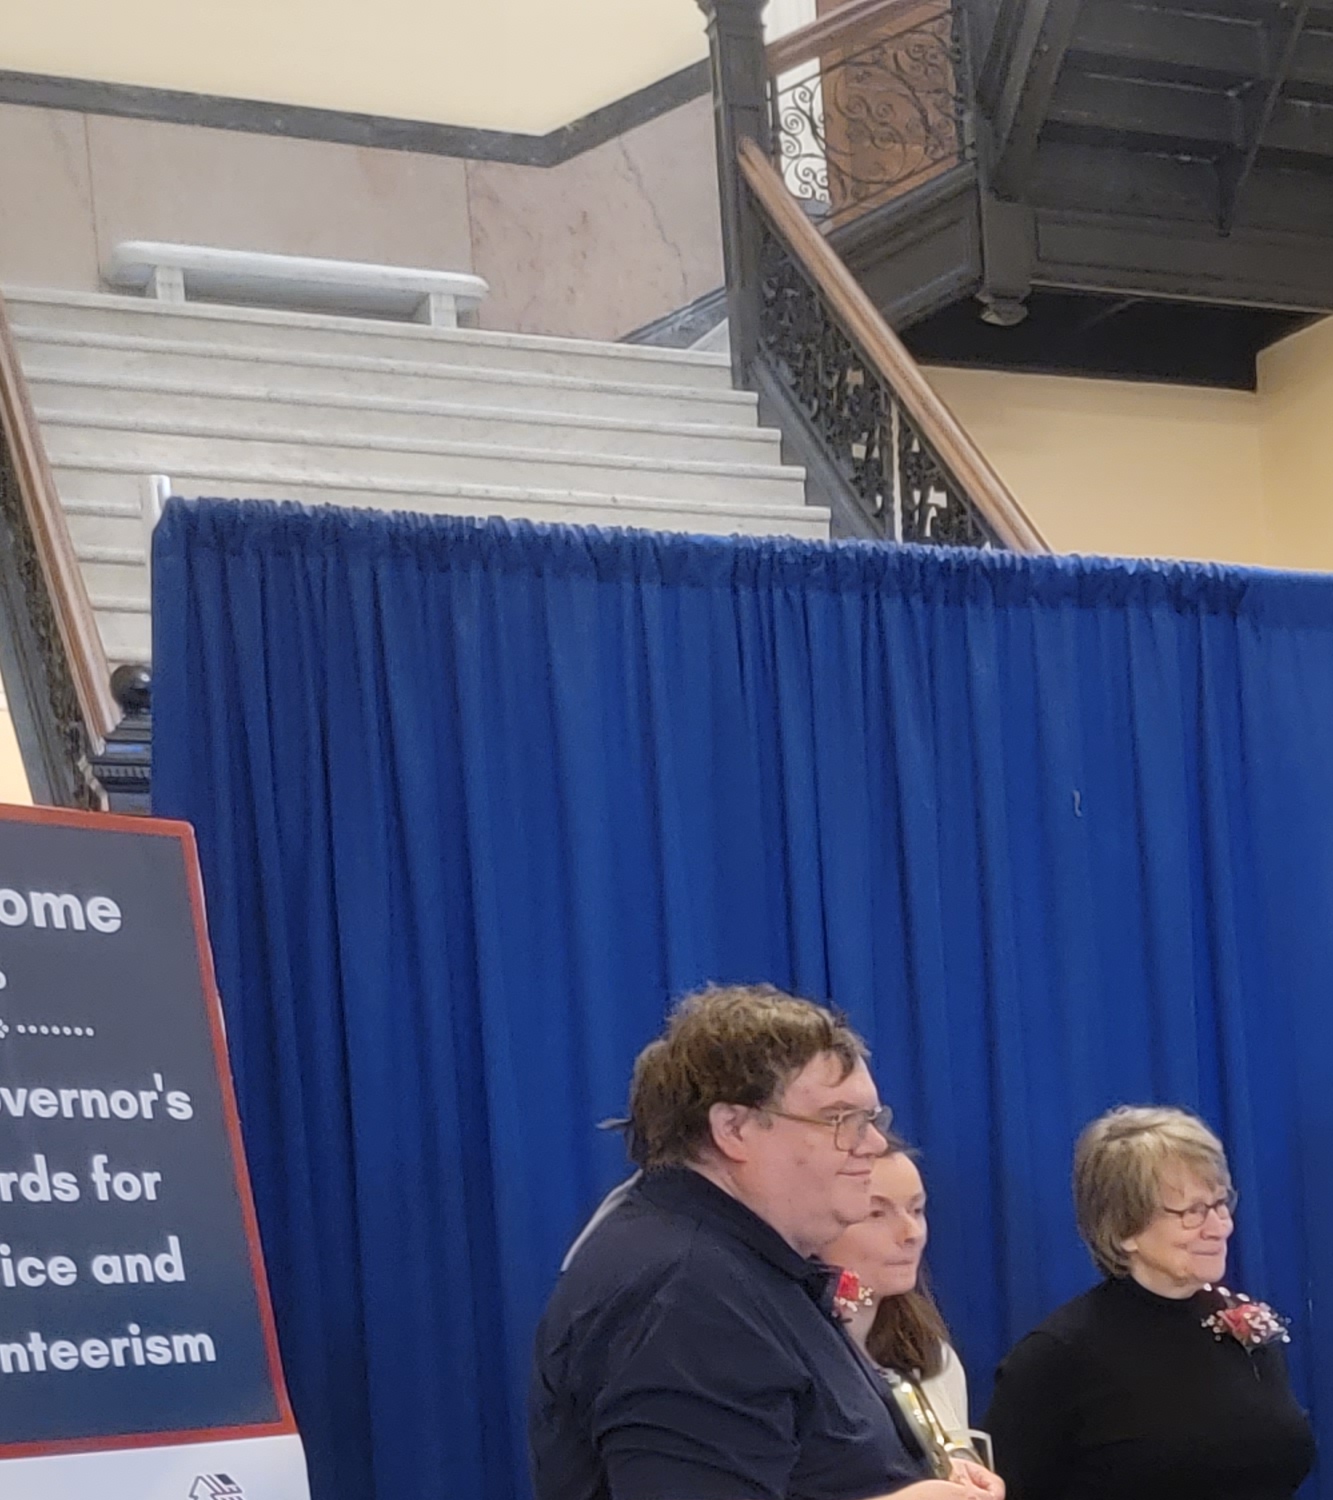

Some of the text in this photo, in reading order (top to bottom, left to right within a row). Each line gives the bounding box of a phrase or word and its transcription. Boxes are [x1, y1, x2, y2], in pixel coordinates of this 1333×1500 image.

[91, 1154, 162, 1202] for
[91, 1235, 186, 1285] and
[0, 1322, 217, 1374] nteerism
